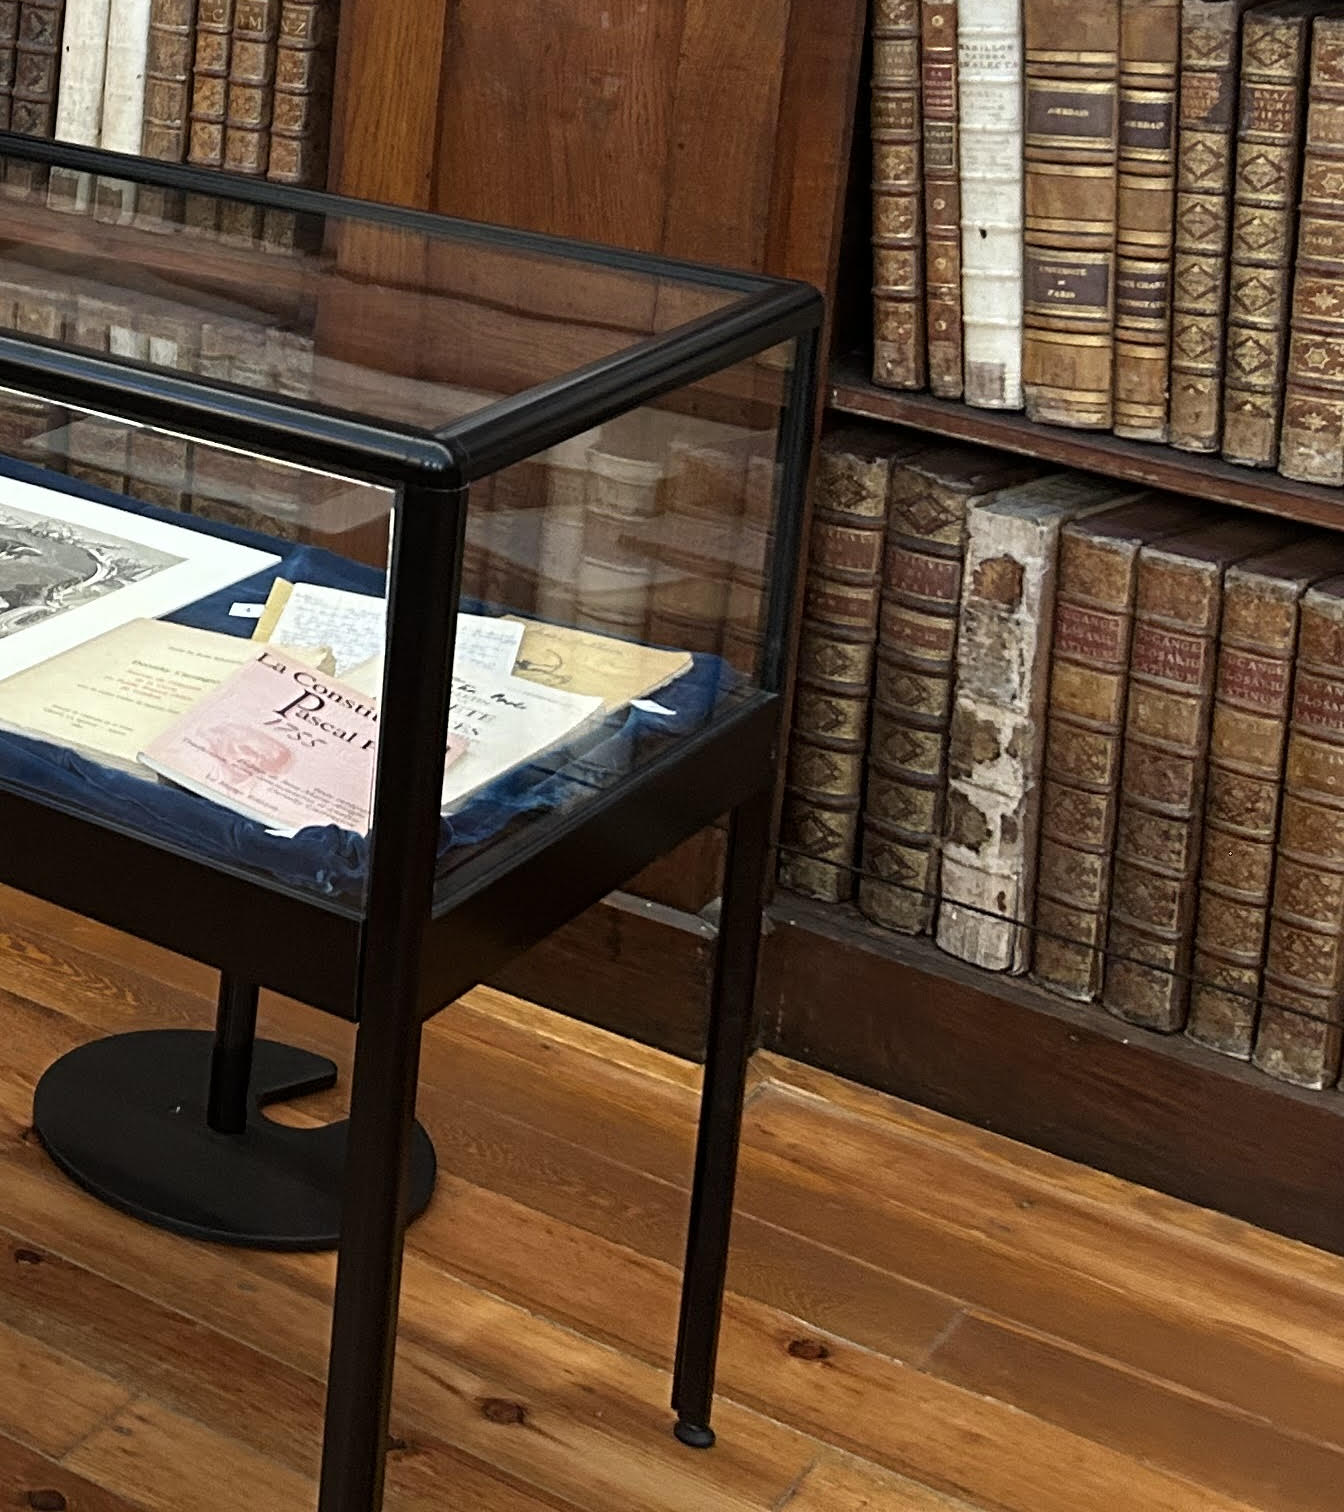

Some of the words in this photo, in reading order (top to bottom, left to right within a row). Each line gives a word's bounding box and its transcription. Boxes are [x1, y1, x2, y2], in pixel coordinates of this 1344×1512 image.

[256, 652, 287, 674] La
[273, 688, 358, 744] Pascal
[263, 718, 328, 747] 1755
